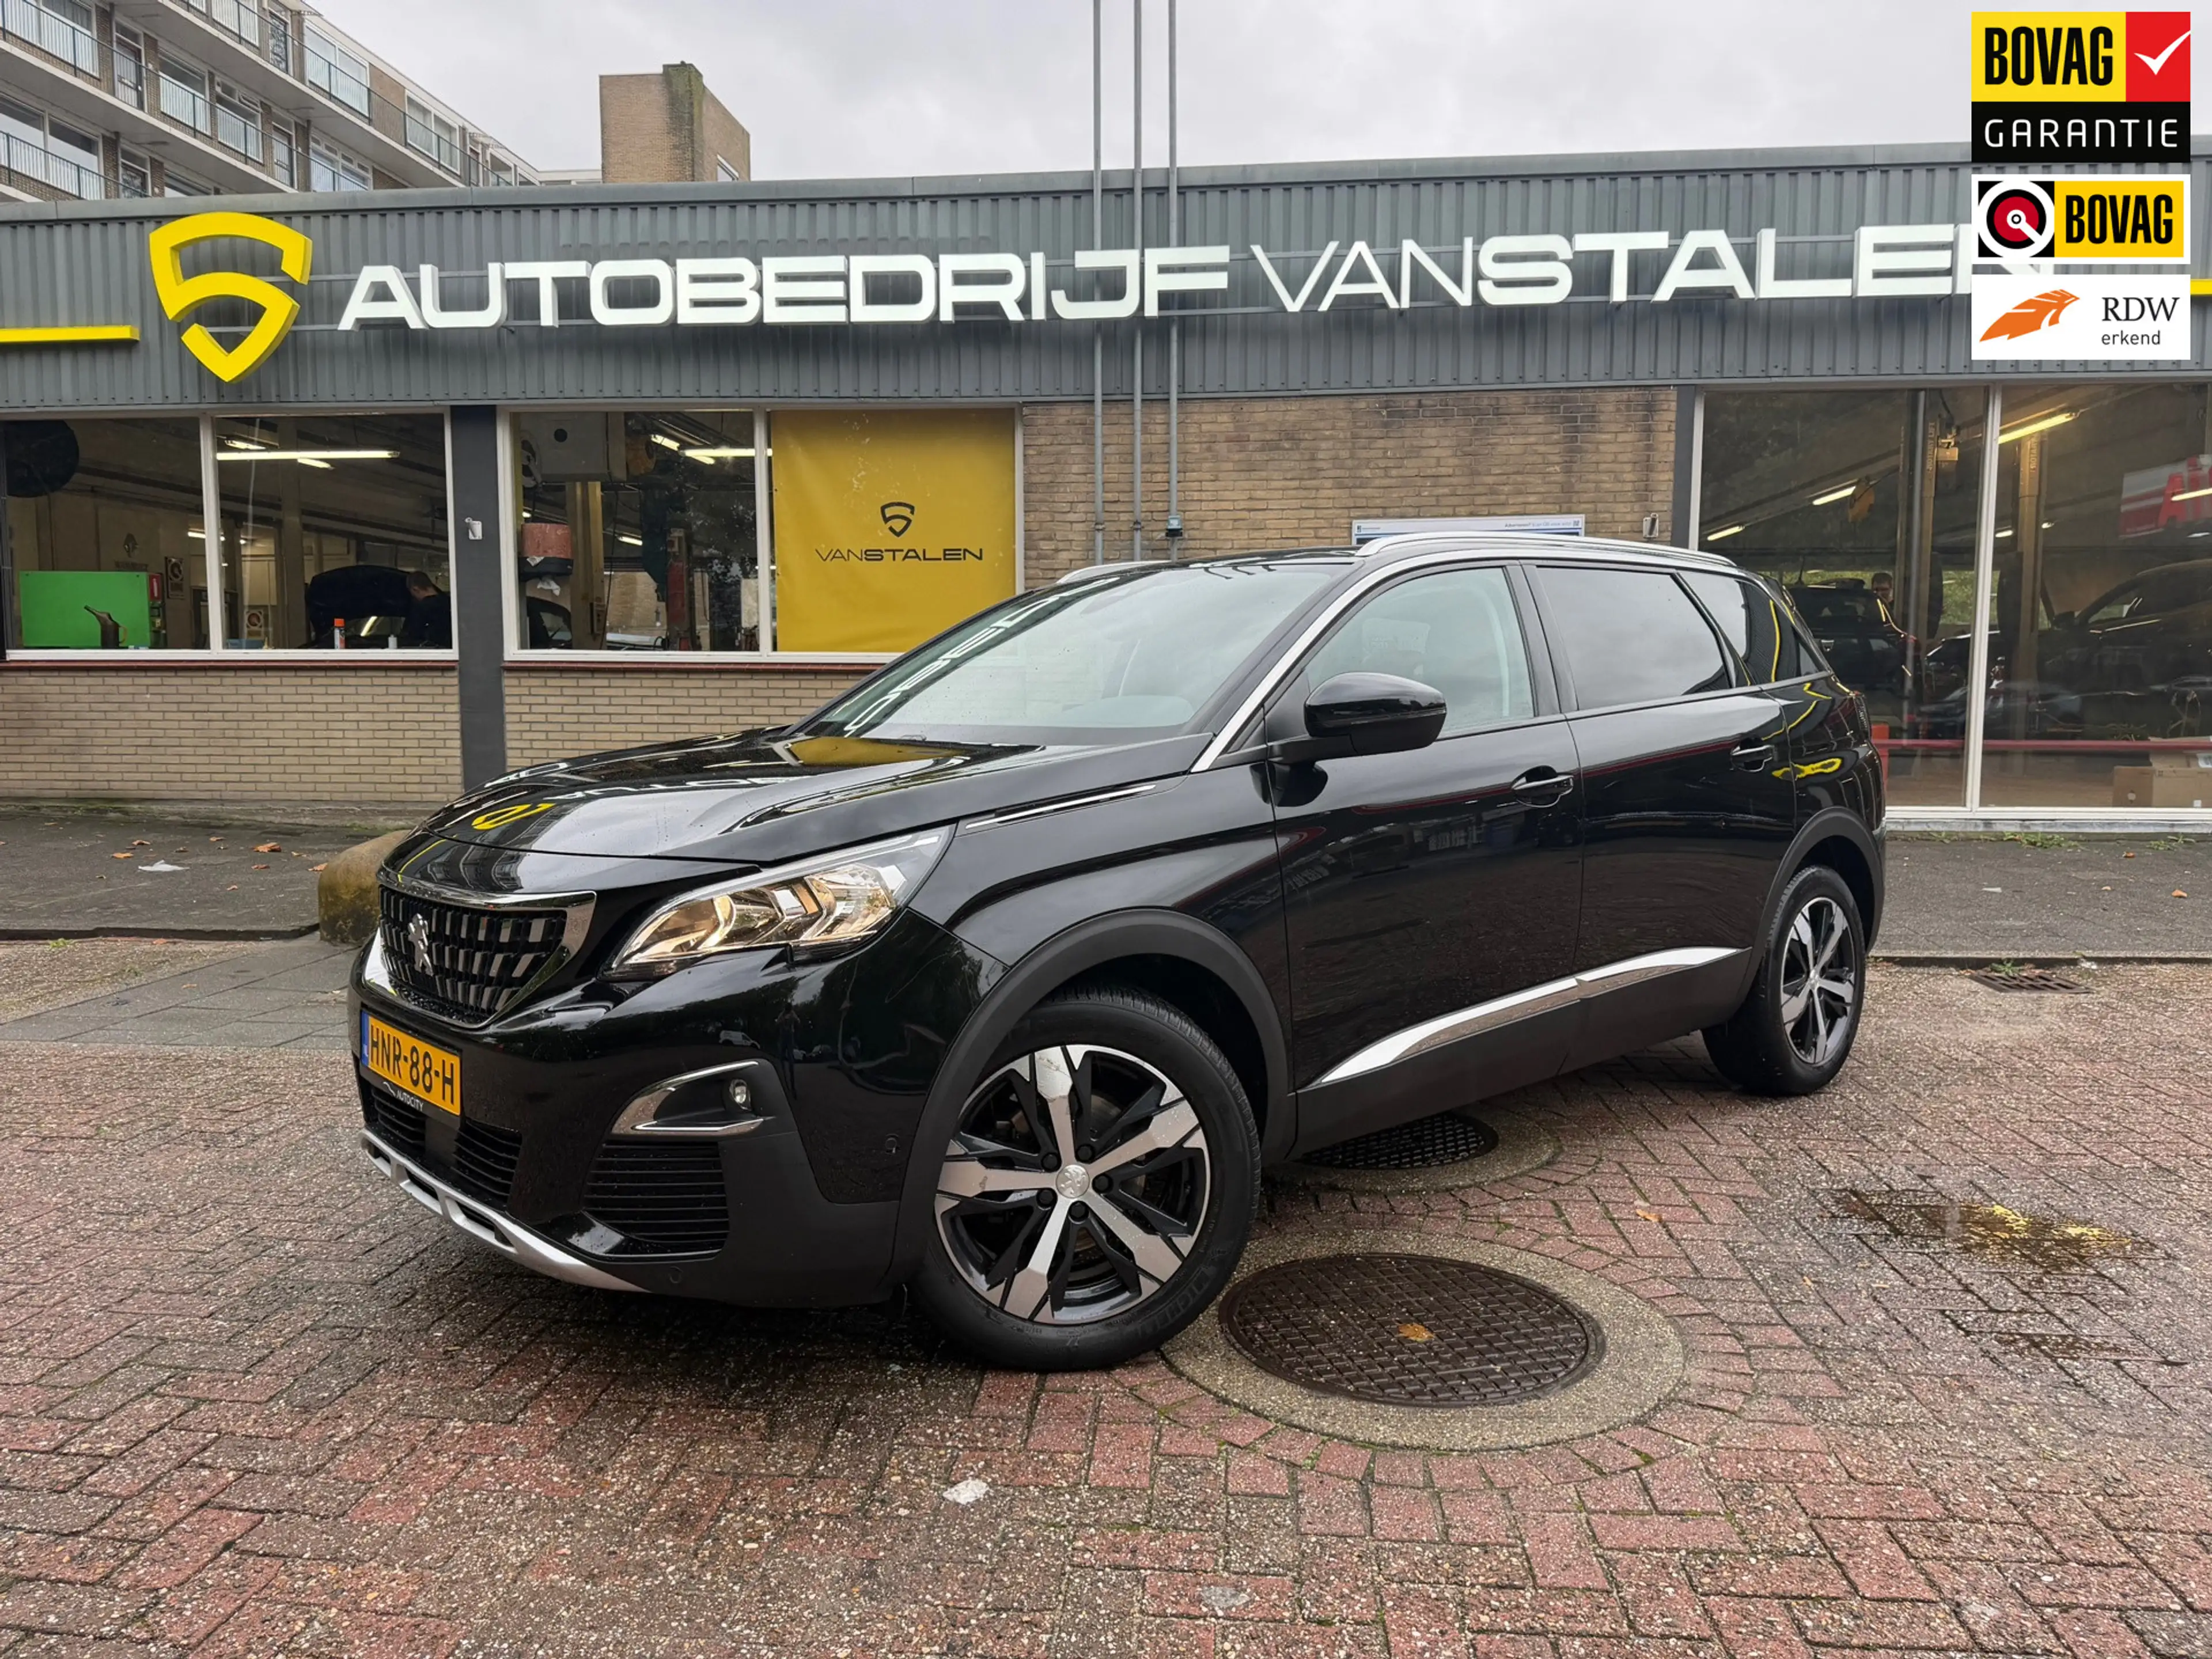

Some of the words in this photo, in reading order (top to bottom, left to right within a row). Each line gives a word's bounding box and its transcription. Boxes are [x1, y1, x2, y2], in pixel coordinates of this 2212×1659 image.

[337, 244, 1230, 331] AUTOBEDRIJF
[1250, 223, 2055, 313] VANSTALE
[815, 548, 983, 562] VANSTALEN
[370, 1024, 454, 1105] HNR-88-H
[395, 1089, 424, 1112] AUTOCITY
